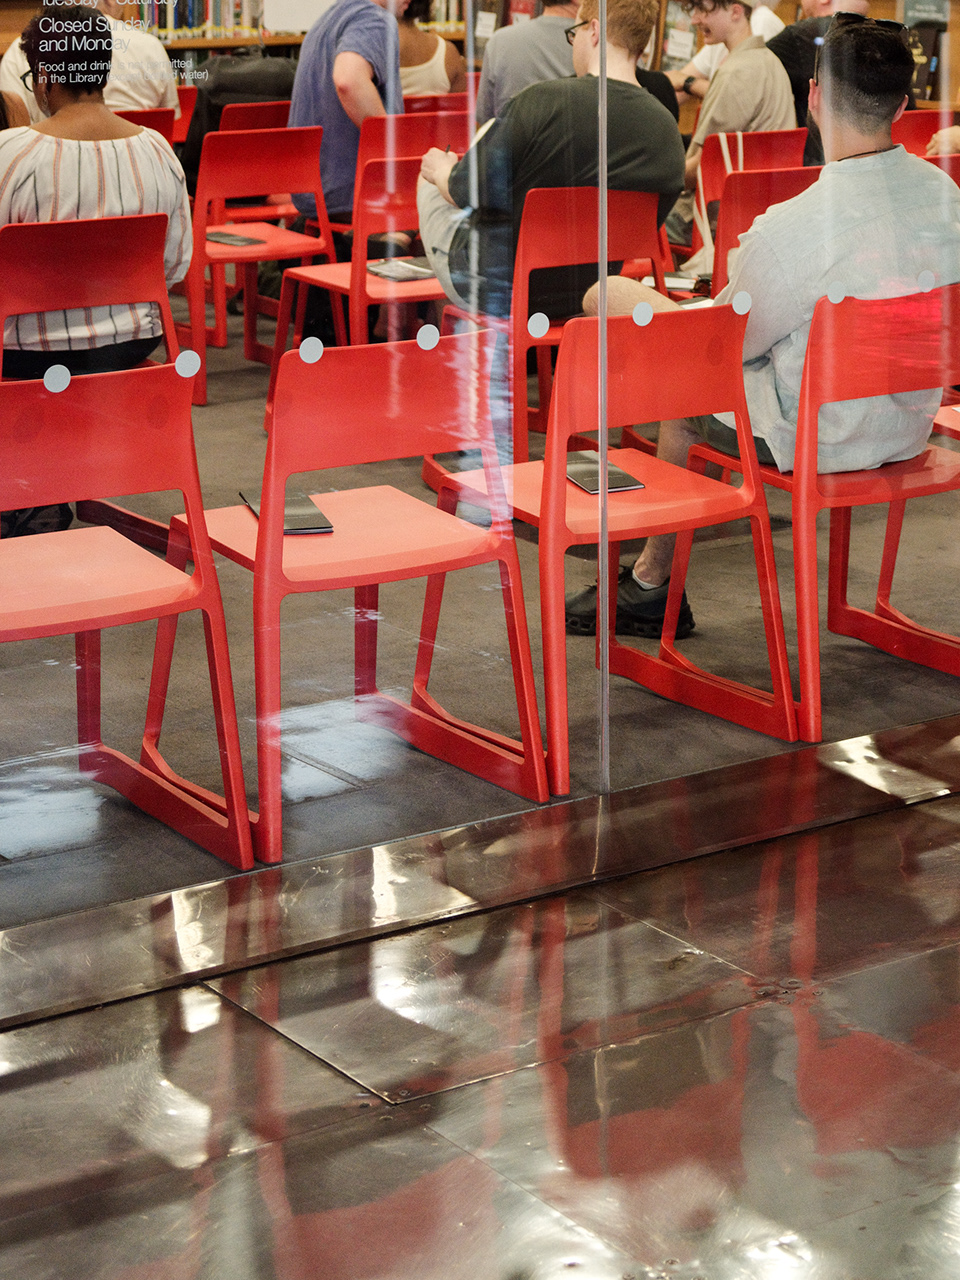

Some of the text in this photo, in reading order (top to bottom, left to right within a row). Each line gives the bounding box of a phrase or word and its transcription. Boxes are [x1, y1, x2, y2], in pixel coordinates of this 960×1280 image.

[38, 16, 150, 34] Closed Sunday
[38, 35, 130, 53] and Monday
[38, 61, 65, 72] Food
[67, 61, 87, 71] and
[89, 60, 114, 71] drink
[38, 74, 47, 84] in
[50, 73, 66, 83] the
[69, 72, 103, 85] Library
[180, 69, 209, 81] water)
